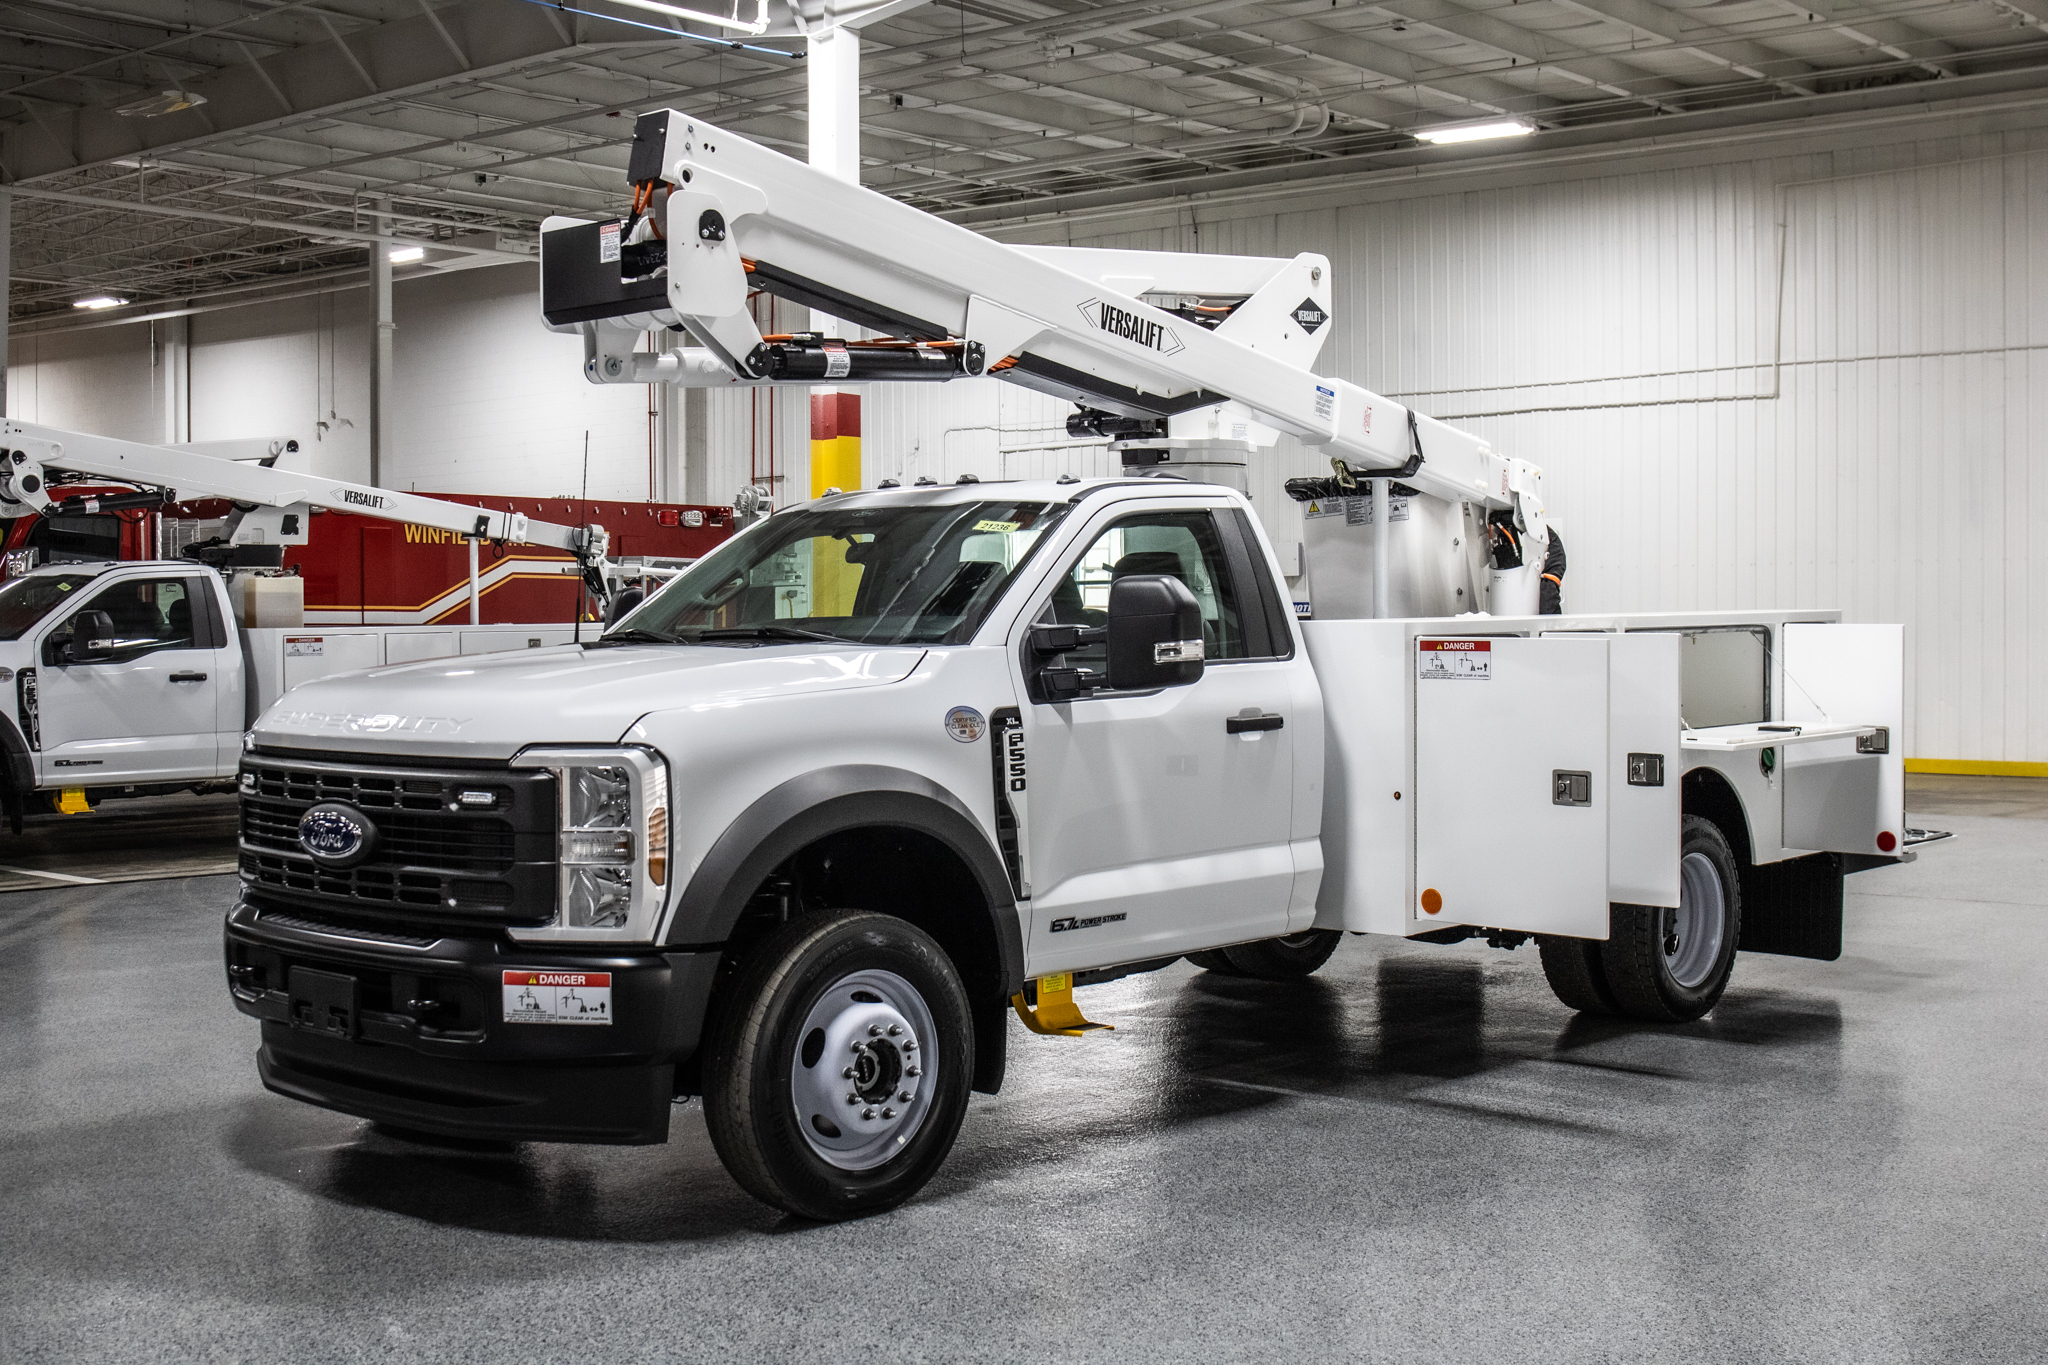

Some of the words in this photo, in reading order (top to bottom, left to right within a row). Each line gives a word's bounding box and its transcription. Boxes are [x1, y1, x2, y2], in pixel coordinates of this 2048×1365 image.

[1298, 310, 1320, 322] VERSALIFT
[1101, 302, 1164, 352] VERSALIFT
[344, 489, 384, 509] VERSALIFT
[981, 522, 1011, 531] 21236
[1444, 642, 1475, 650] DANGER
[1006, 717, 1020, 725] XL
[1009, 732, 1027, 792] F550
[310, 820, 346, 848] Ford
[1080, 917, 1102, 926] POWER
[1102, 912, 1127, 923] STROKE
[539, 975, 586, 985] DANGER
